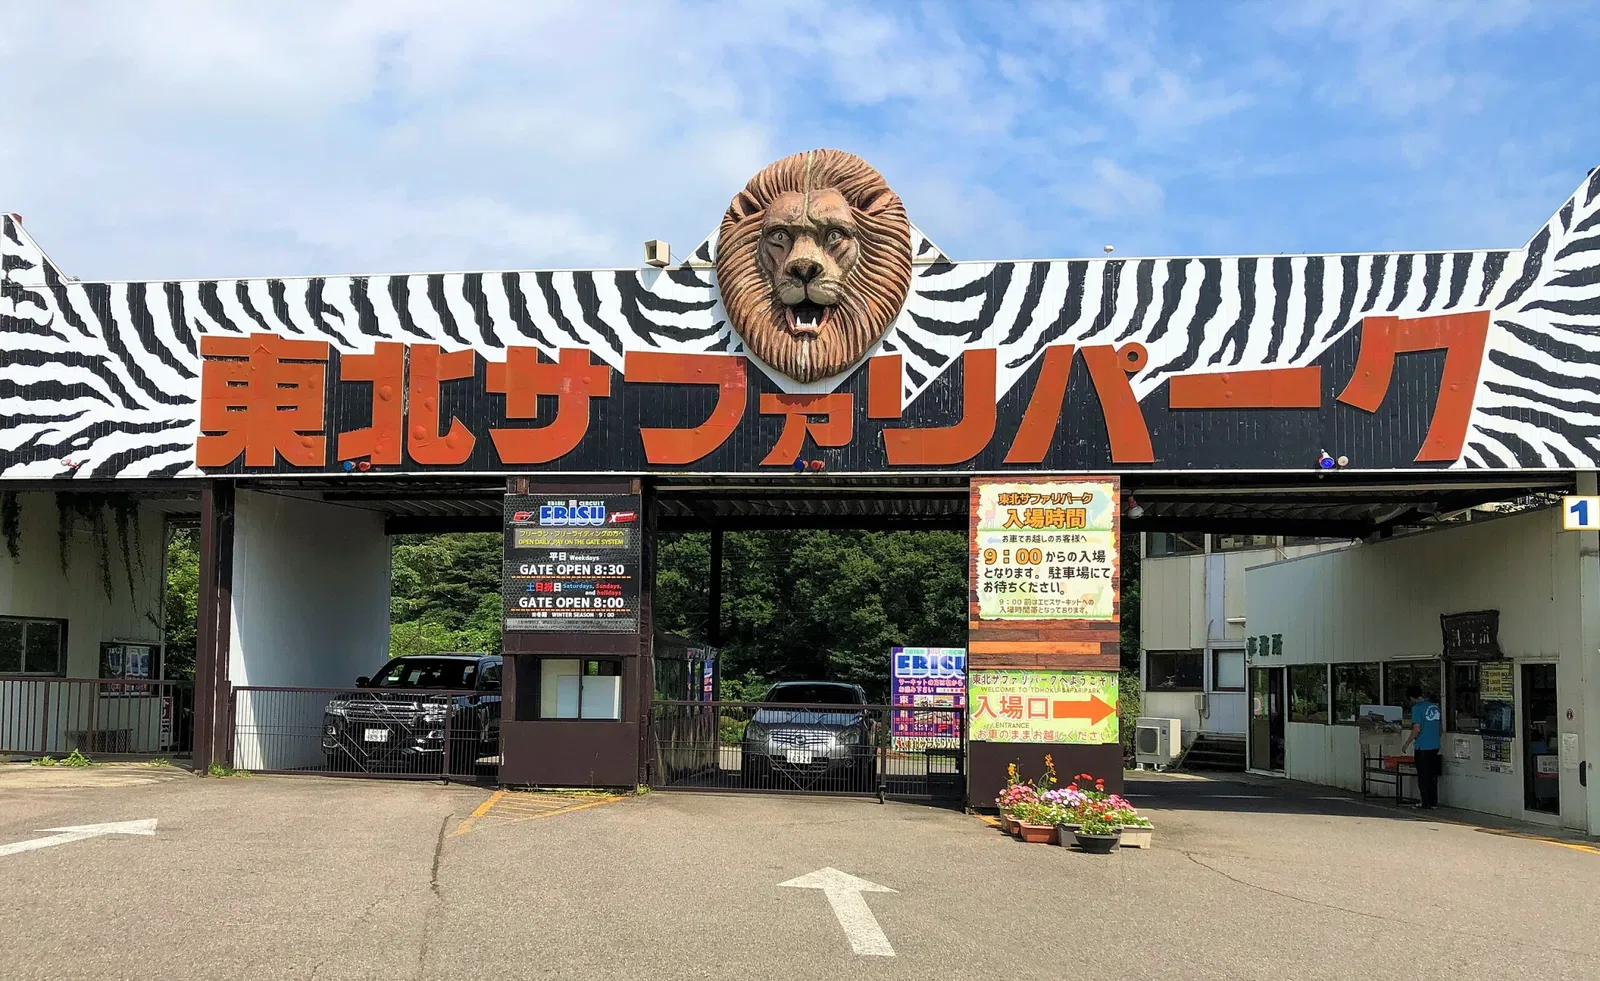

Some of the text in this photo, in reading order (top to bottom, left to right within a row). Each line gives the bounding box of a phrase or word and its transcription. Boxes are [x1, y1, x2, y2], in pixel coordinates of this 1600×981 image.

[197, 310, 1490, 469] 東北サファリパーク
[997, 492, 1093, 506] 東北サファリパーク
[540, 505, 606, 526] EBISU
[1003, 508, 1087, 529] 入場時間
[1571, 500, 1588, 526] 1
[1002, 534, 1087, 544] お車でお越しのお客様へ
[549, 552, 600, 562] 平日 Weekdays
[1046, 550, 1106, 563] からの入場
[519, 564, 625, 576] GATE OPEN 8:30
[984, 566, 1111, 580] となります。 駐車場にて
[526, 582, 562, 592] 土日祝日
[983, 581, 1065, 595] お待ちください。
[518, 597, 624, 608] GATE OPEN 8:00
[973, 695, 1049, 720] 入場口
[977, 730, 1112, 742] お車のままお越しください
